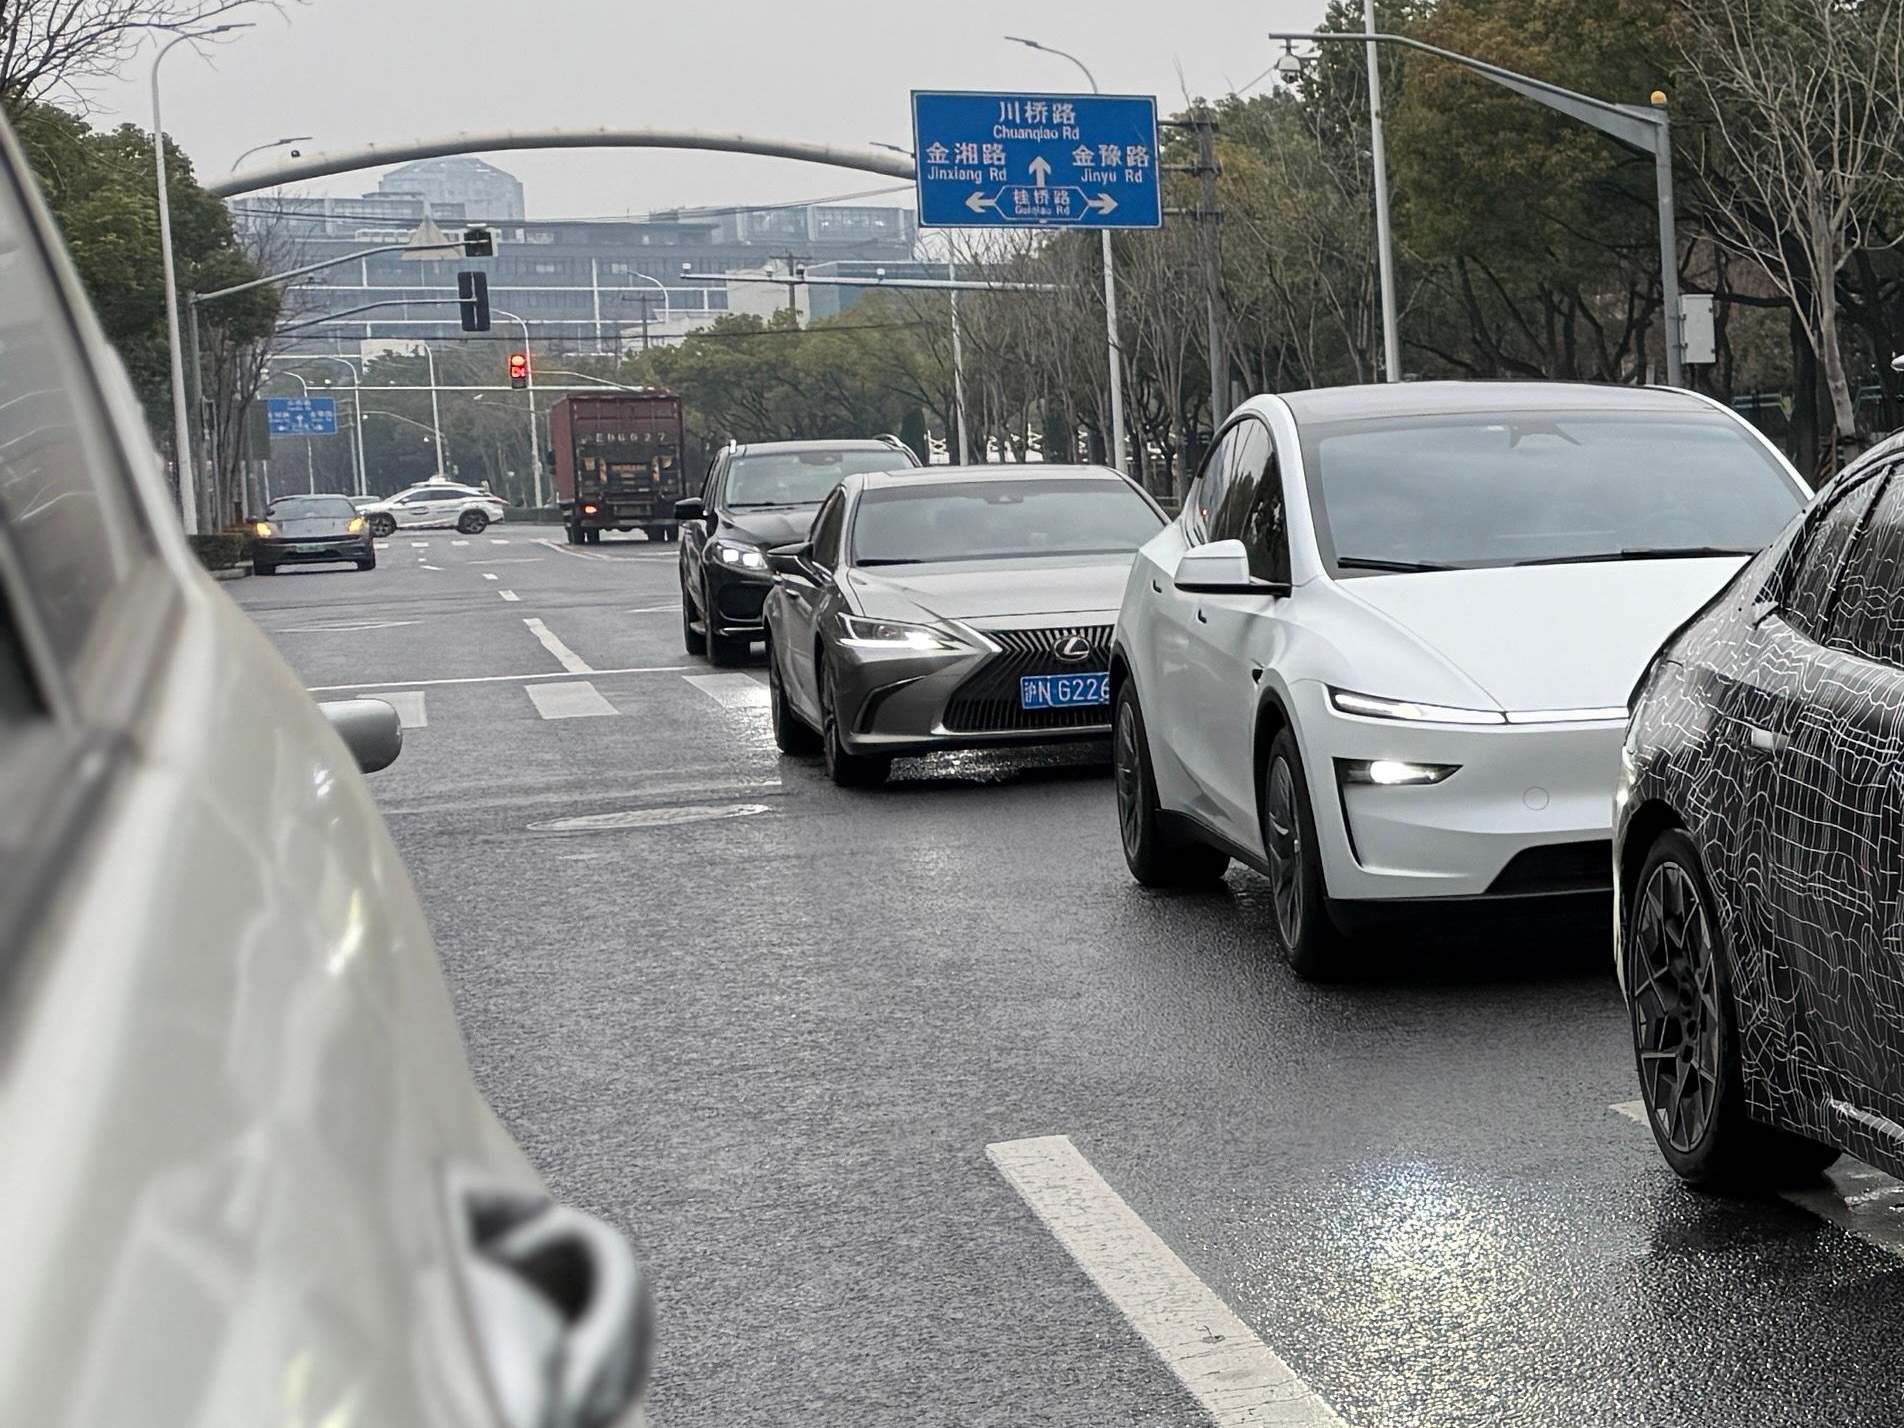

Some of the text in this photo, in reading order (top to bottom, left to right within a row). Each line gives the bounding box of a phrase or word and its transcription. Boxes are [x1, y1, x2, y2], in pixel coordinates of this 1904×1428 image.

[999, 101, 1076, 124] 川桥路
[993, 125, 1080, 142] Chuanqiao Rd
[926, 142, 1006, 165] 金湘路
[1072, 144, 1149, 167] 金豫路
[927, 166, 1007, 184] Jinxiang Rd
[1081, 168, 1143, 186] Jinyu Rd
